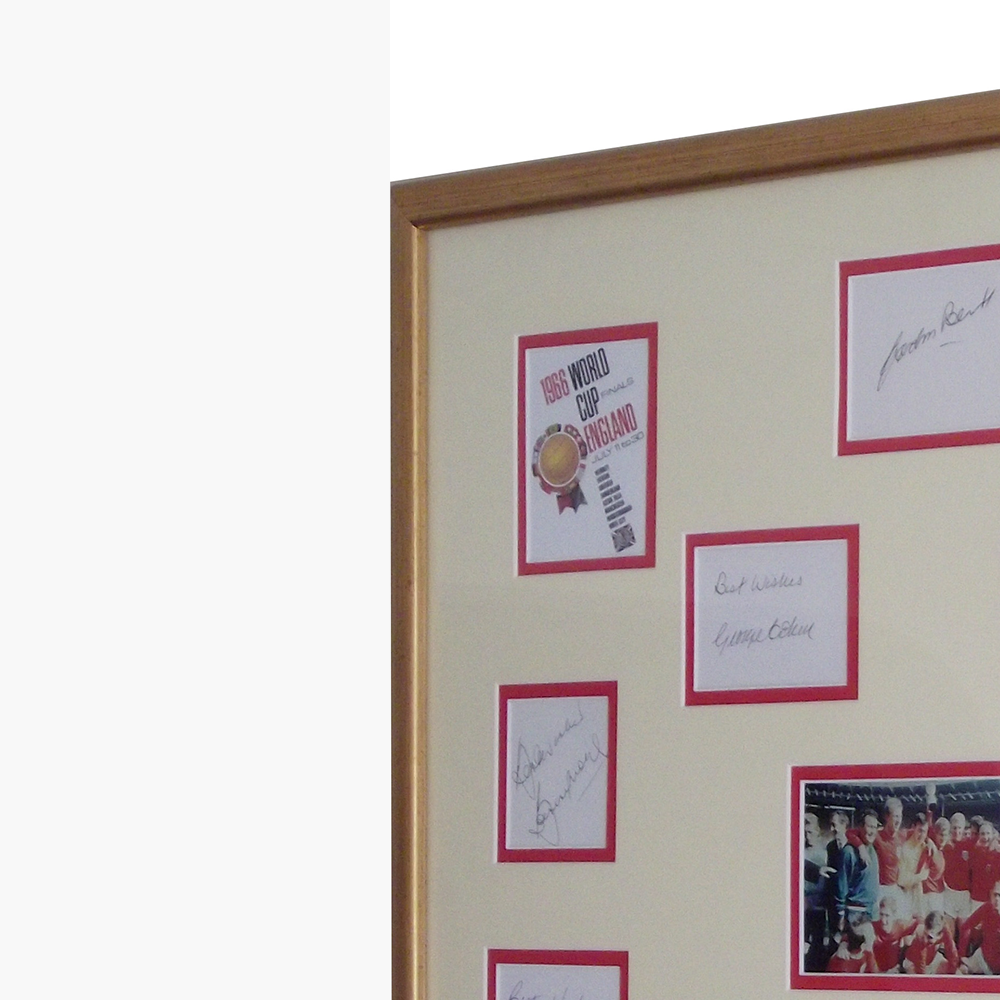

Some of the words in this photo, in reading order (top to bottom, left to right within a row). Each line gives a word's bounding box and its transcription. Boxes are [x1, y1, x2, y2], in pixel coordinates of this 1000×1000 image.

[540, 368, 571, 405] 1966
[567, 347, 610, 391] WORLD
[575, 386, 600, 422] CUP
[600, 377, 635, 399] FINALS
[582, 403, 638, 453] ENGLAND
